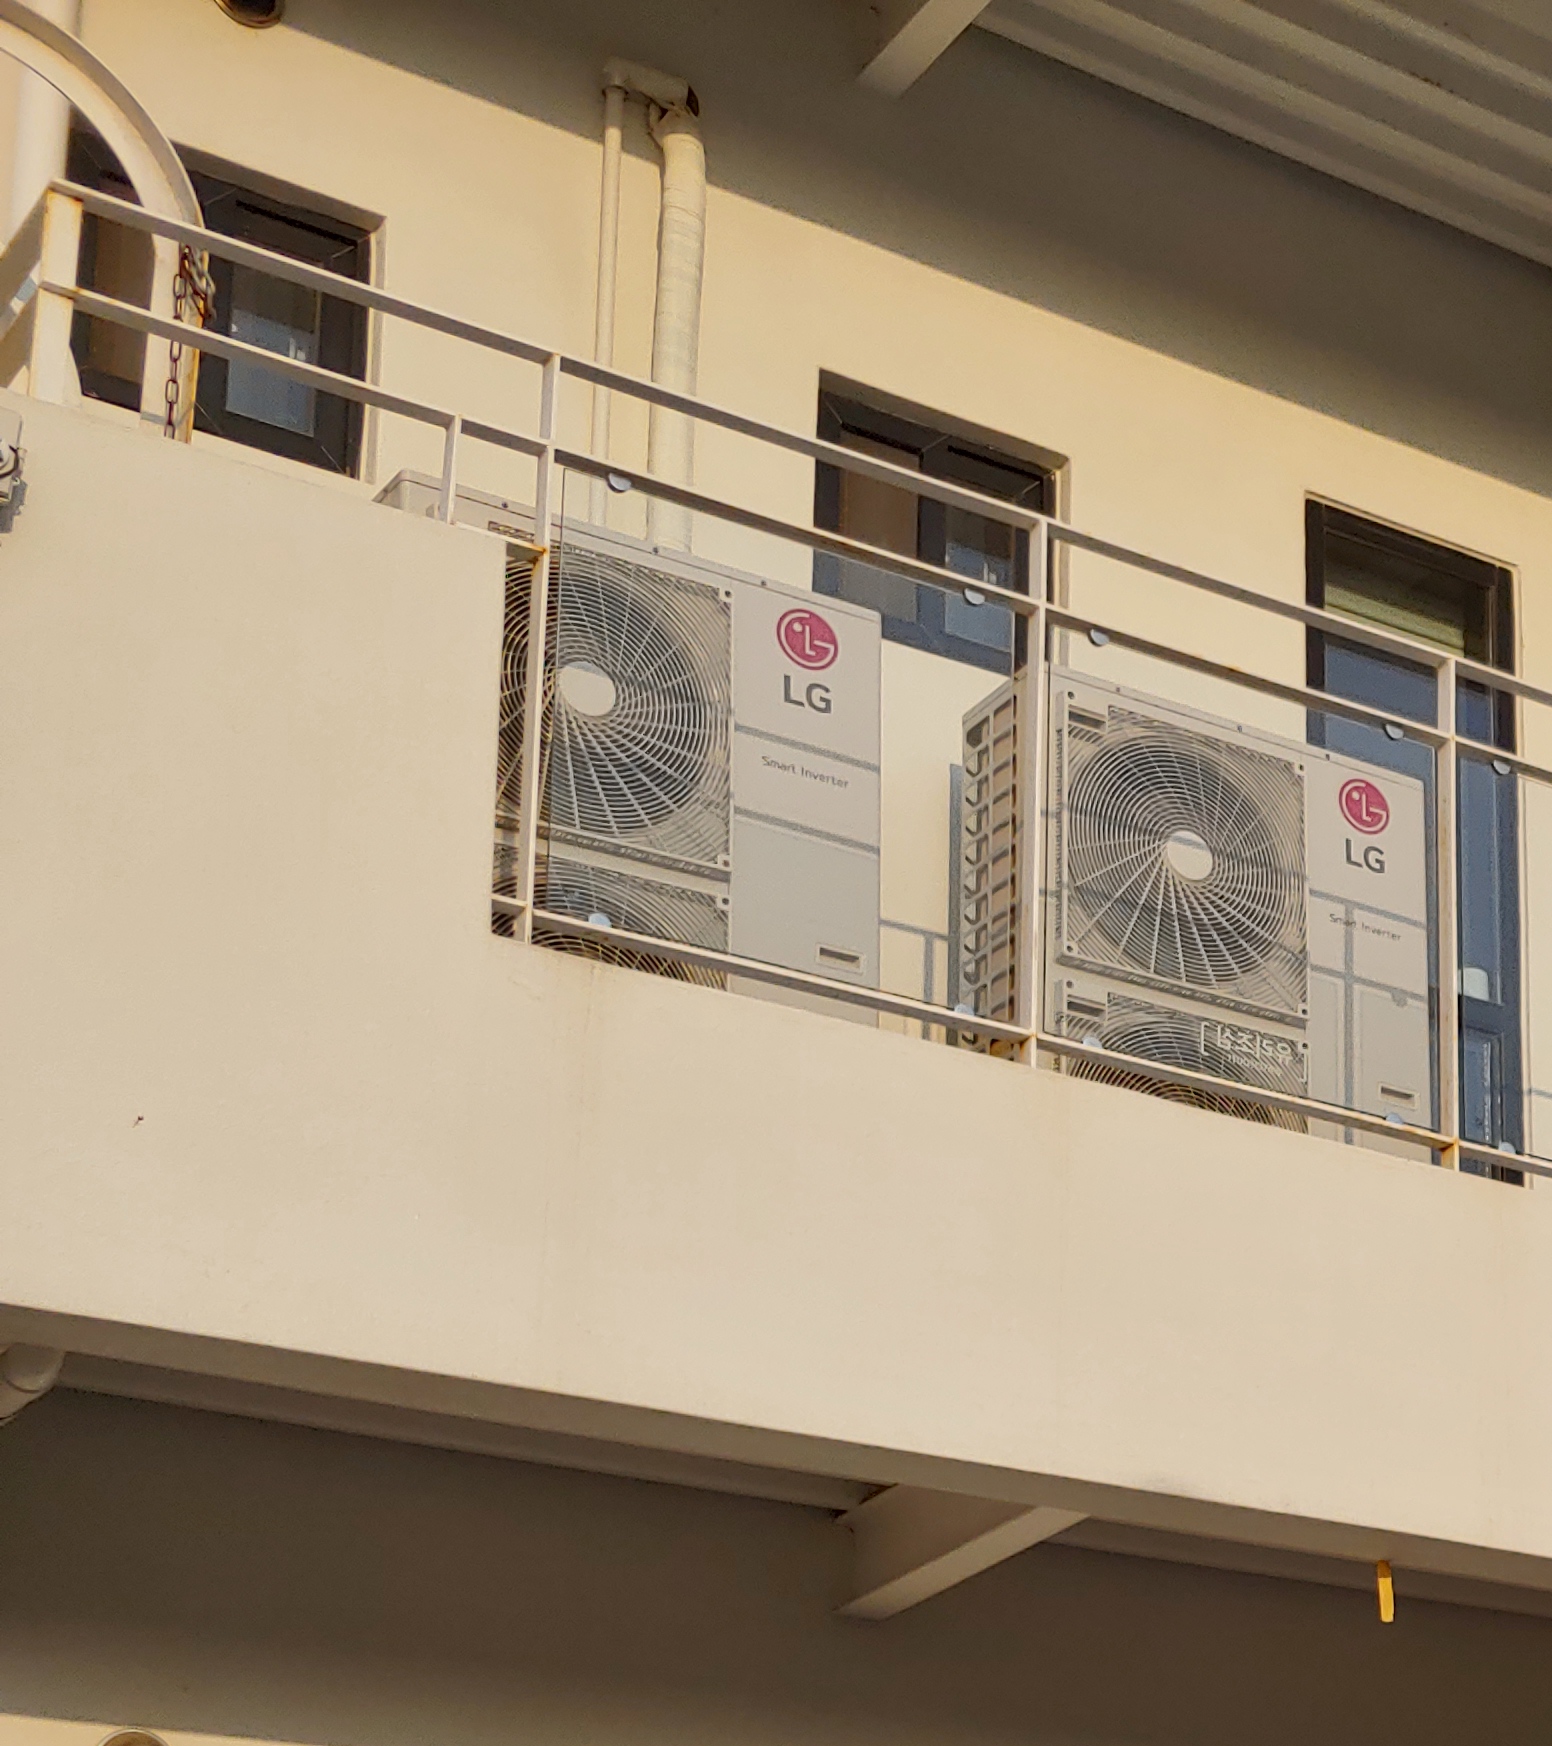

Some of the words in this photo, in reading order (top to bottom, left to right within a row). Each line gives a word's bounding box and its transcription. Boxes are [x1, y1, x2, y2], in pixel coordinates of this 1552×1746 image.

[783, 674, 832, 714] LG
[761, 755, 796, 774] Smart
[801, 766, 849, 788] Inverter
[1345, 839, 1386, 874] LG
[1361, 921, 1402, 942] Inverter
